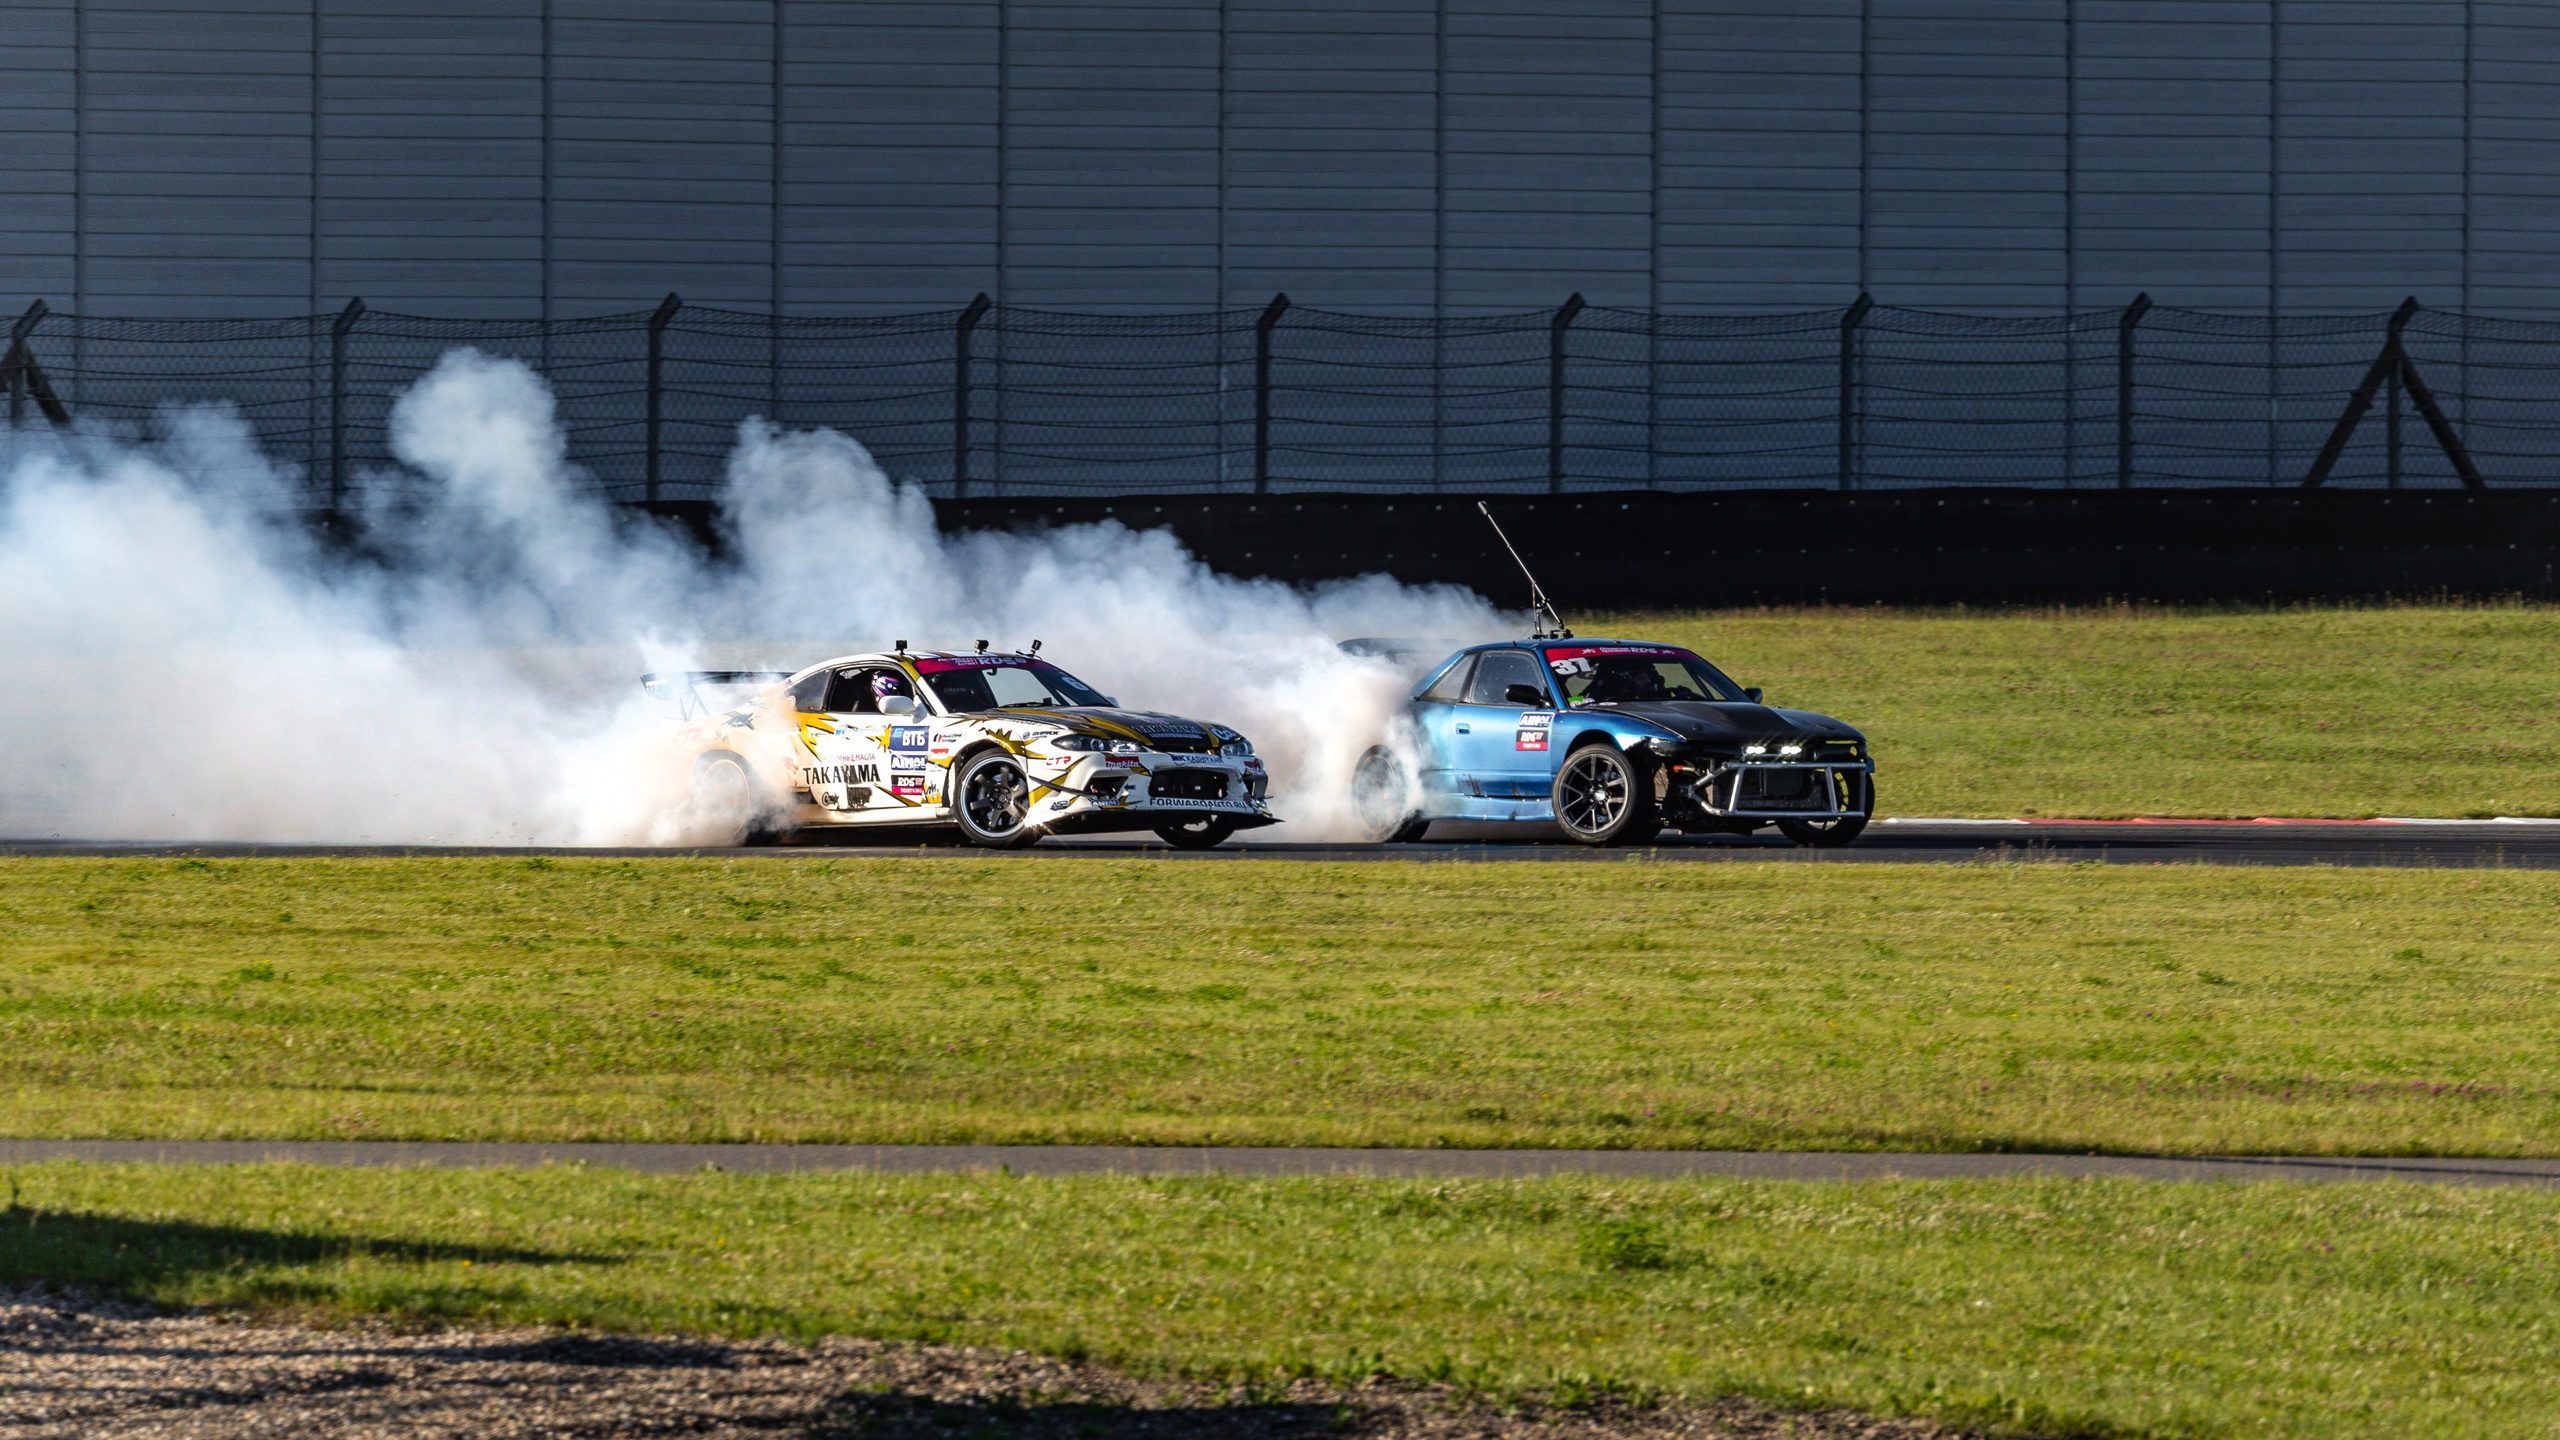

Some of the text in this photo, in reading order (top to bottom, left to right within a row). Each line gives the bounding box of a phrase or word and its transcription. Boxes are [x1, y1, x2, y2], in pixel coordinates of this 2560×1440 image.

[977, 657, 1016, 665] RDS
[1550, 657, 1591, 675] 37
[902, 730, 926, 747] ВТБ
[1046, 755, 1072, 766] CTR
[1105, 760, 1141, 768] makita
[802, 764, 881, 784] TAKAYAMA
[897, 777, 915, 787] RDS
